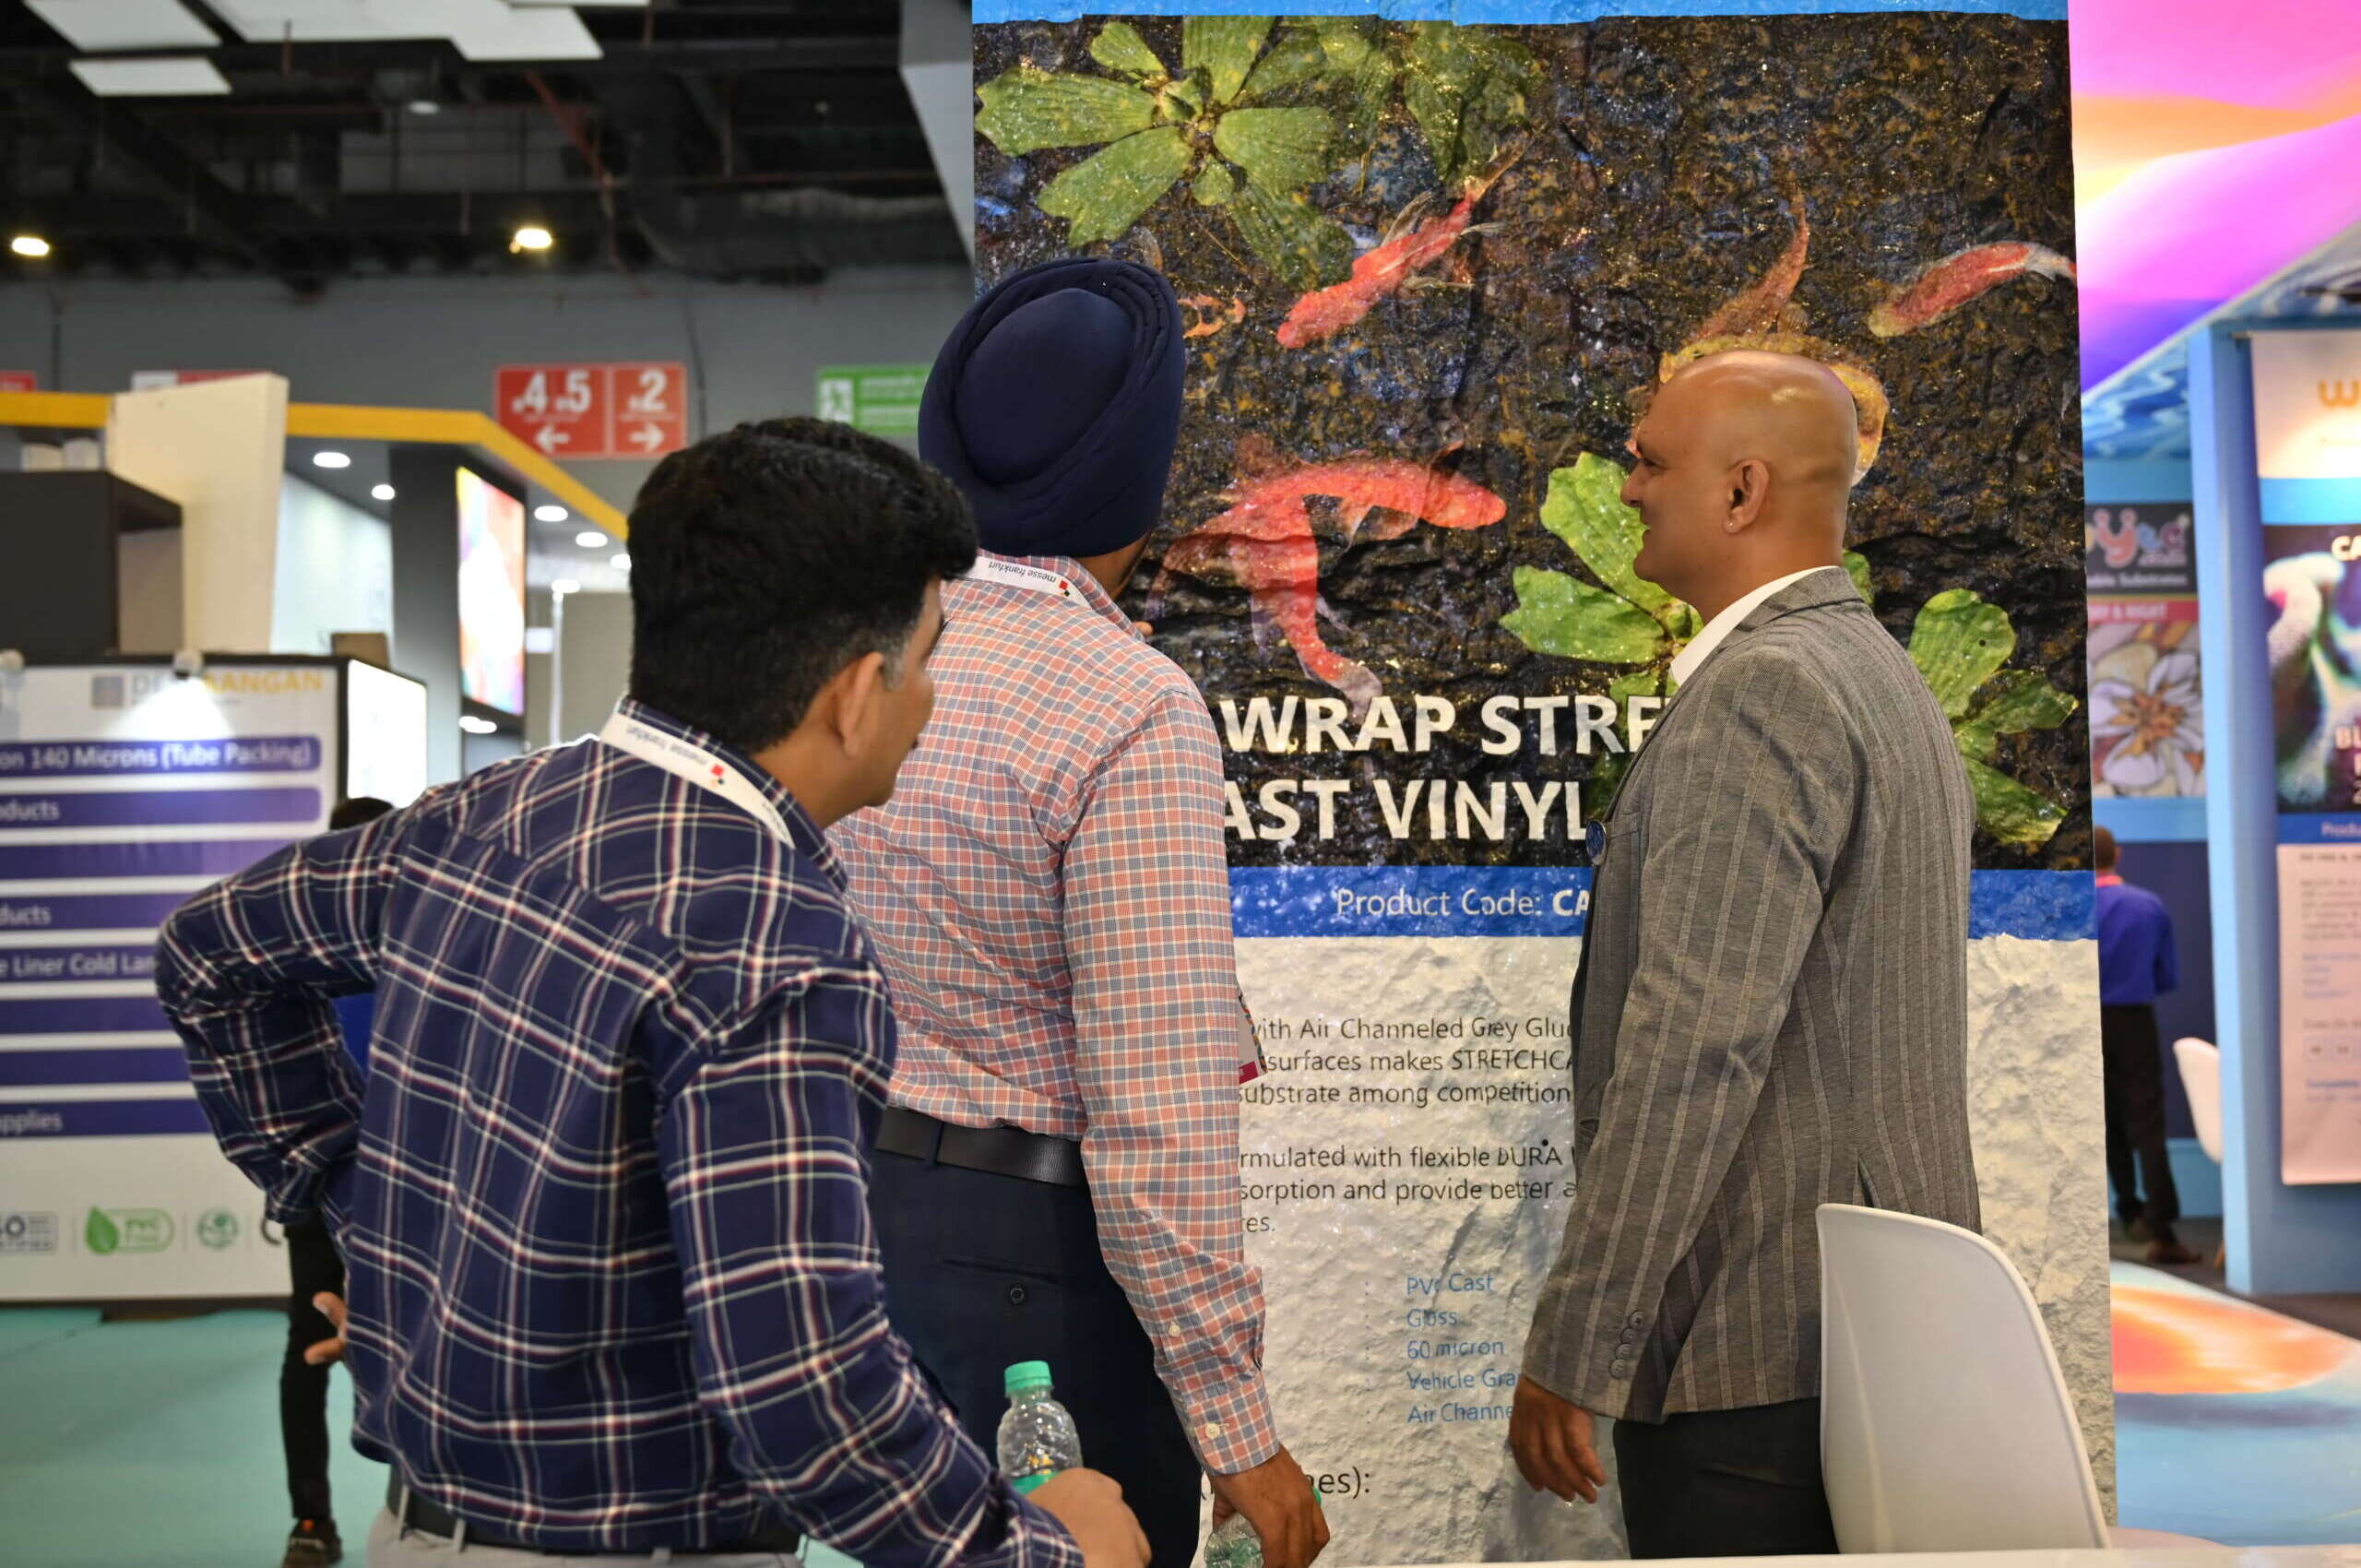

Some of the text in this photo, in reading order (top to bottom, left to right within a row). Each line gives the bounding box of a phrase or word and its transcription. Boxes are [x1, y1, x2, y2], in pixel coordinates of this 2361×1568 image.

[989, 561, 1057, 583] messe frankfurt
[1219, 695, 1456, 753] WRAP
[30, 745, 69, 769] 140
[74, 743, 159, 768] Microns
[161, 742, 219, 771] (Tube
[226, 740, 312, 769] Packing)
[1372, 780, 1586, 840] VINYL
[1337, 888, 1452, 917] Product
[1461, 888, 1541, 917] Code:
[69, 951, 115, 976] Cold
[1257, 1017, 1291, 1039] ith
[1299, 1018, 1330, 1039] Air
[1340, 1017, 1464, 1039] Channeled
[1471, 1016, 1518, 1043] Grey
[1267, 1050, 1362, 1071] surfaces
[1370, 1050, 1443, 1071] makes
[1348, 1086, 1429, 1109] among
[1437, 1081, 1572, 1106] competition
[1240, 1145, 1346, 1168] rmulated
[1354, 1146, 1403, 1168] with
[1410, 1146, 1490, 1168] flexible
[1497, 1146, 1563, 1168] DURA
[1343, 1179, 1386, 1200] and
[1396, 1178, 1482, 1206] provide
[1490, 1180, 1554, 1200] better
[1448, 1272, 1495, 1292] Cast
[1406, 1340, 1505, 1360] 60 micron
[1406, 1369, 1476, 1391] Vehicle
[1406, 1404, 1436, 1424] Air
